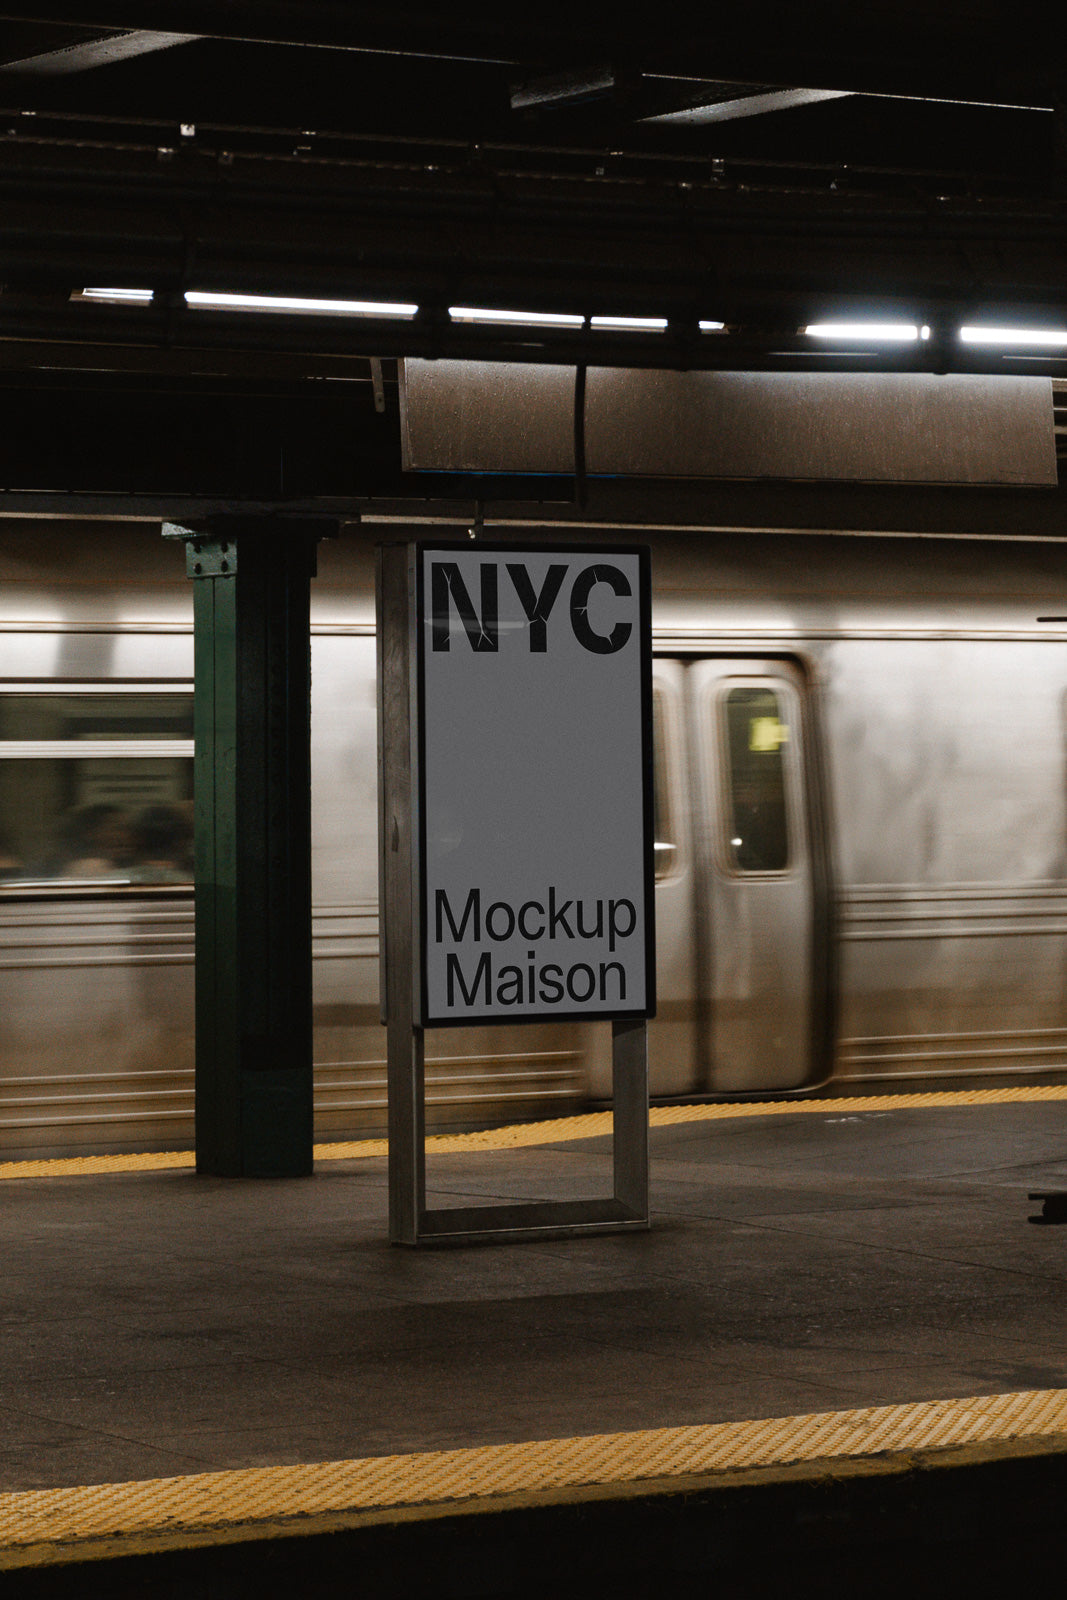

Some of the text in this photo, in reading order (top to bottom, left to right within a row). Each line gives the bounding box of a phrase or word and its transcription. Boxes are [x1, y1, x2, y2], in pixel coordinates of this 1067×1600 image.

[431, 562, 632, 654] NYC
[435, 887, 637, 952] Mockup
[446, 951, 626, 1007] Maison
